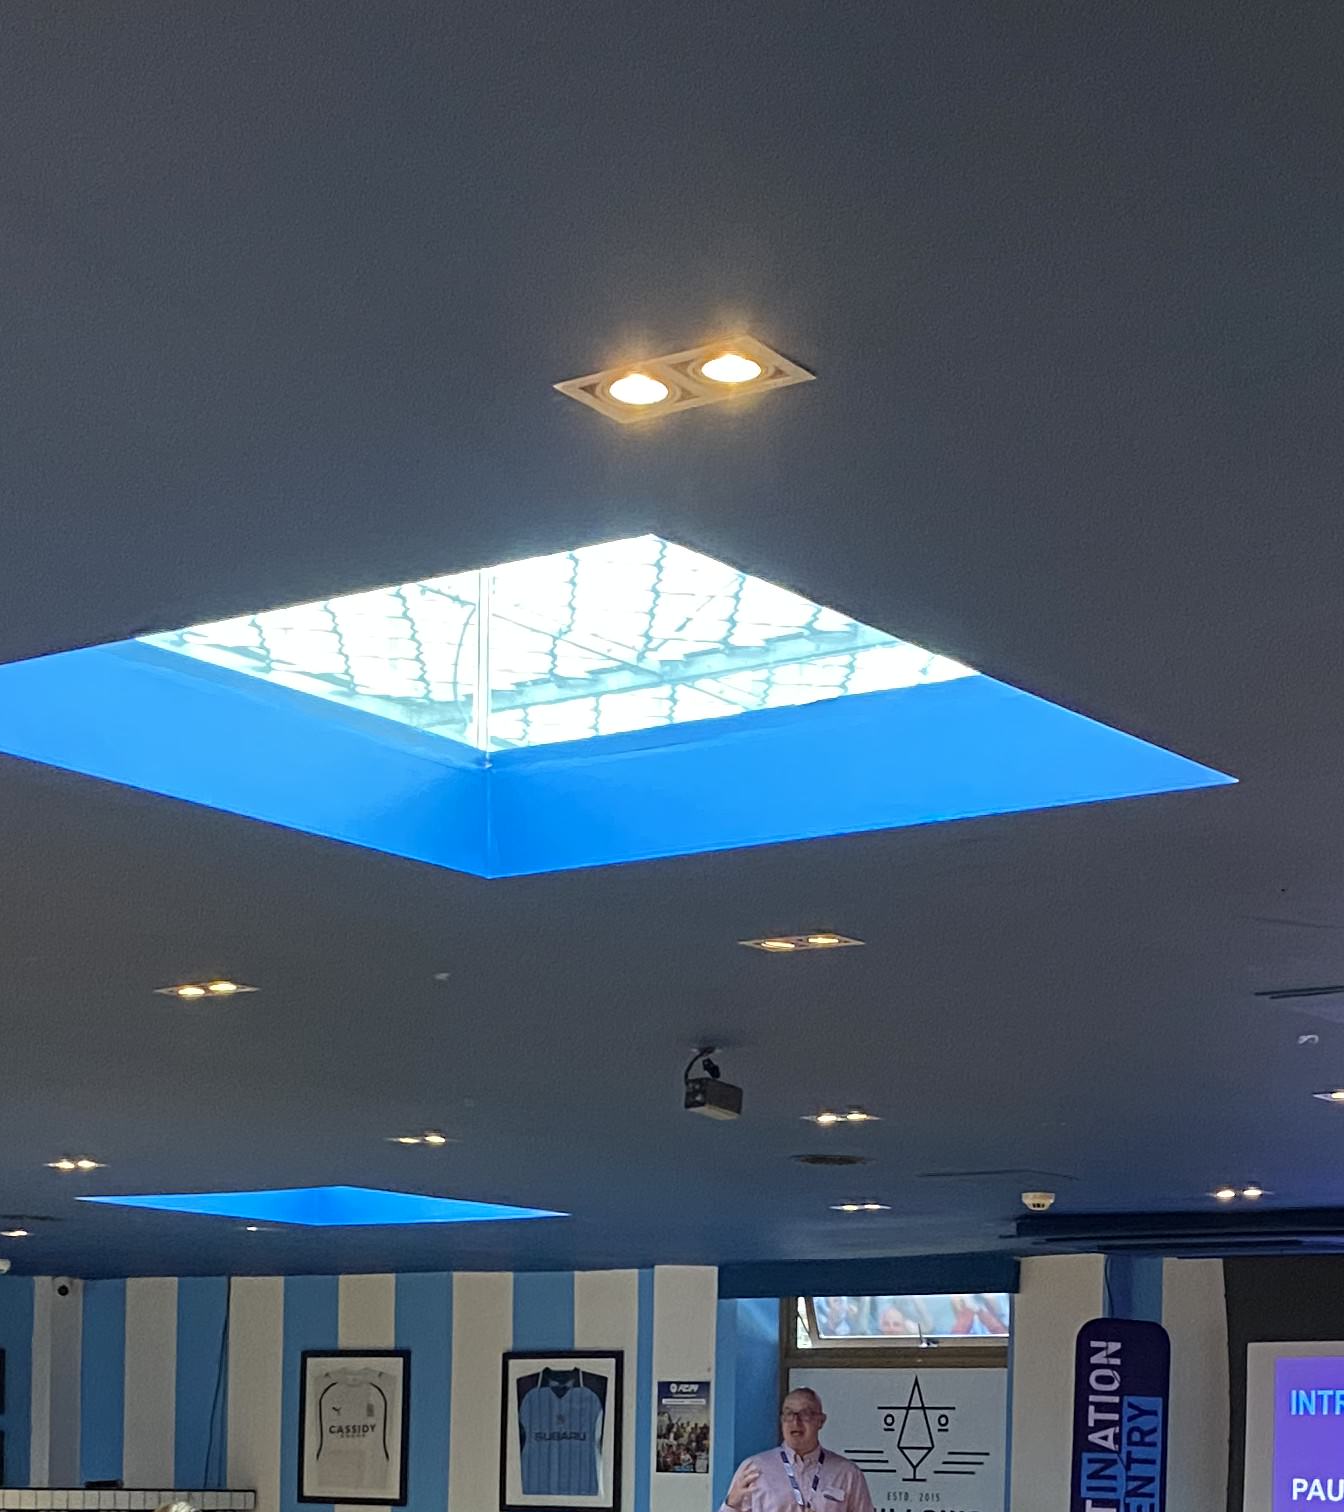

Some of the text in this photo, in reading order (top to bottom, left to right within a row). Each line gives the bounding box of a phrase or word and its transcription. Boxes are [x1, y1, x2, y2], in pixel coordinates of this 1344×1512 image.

[329, 1424, 376, 1434] CASSIDY
[535, 1432, 587, 1442] SUBARU
[919, 1493, 940, 1502] 2015
